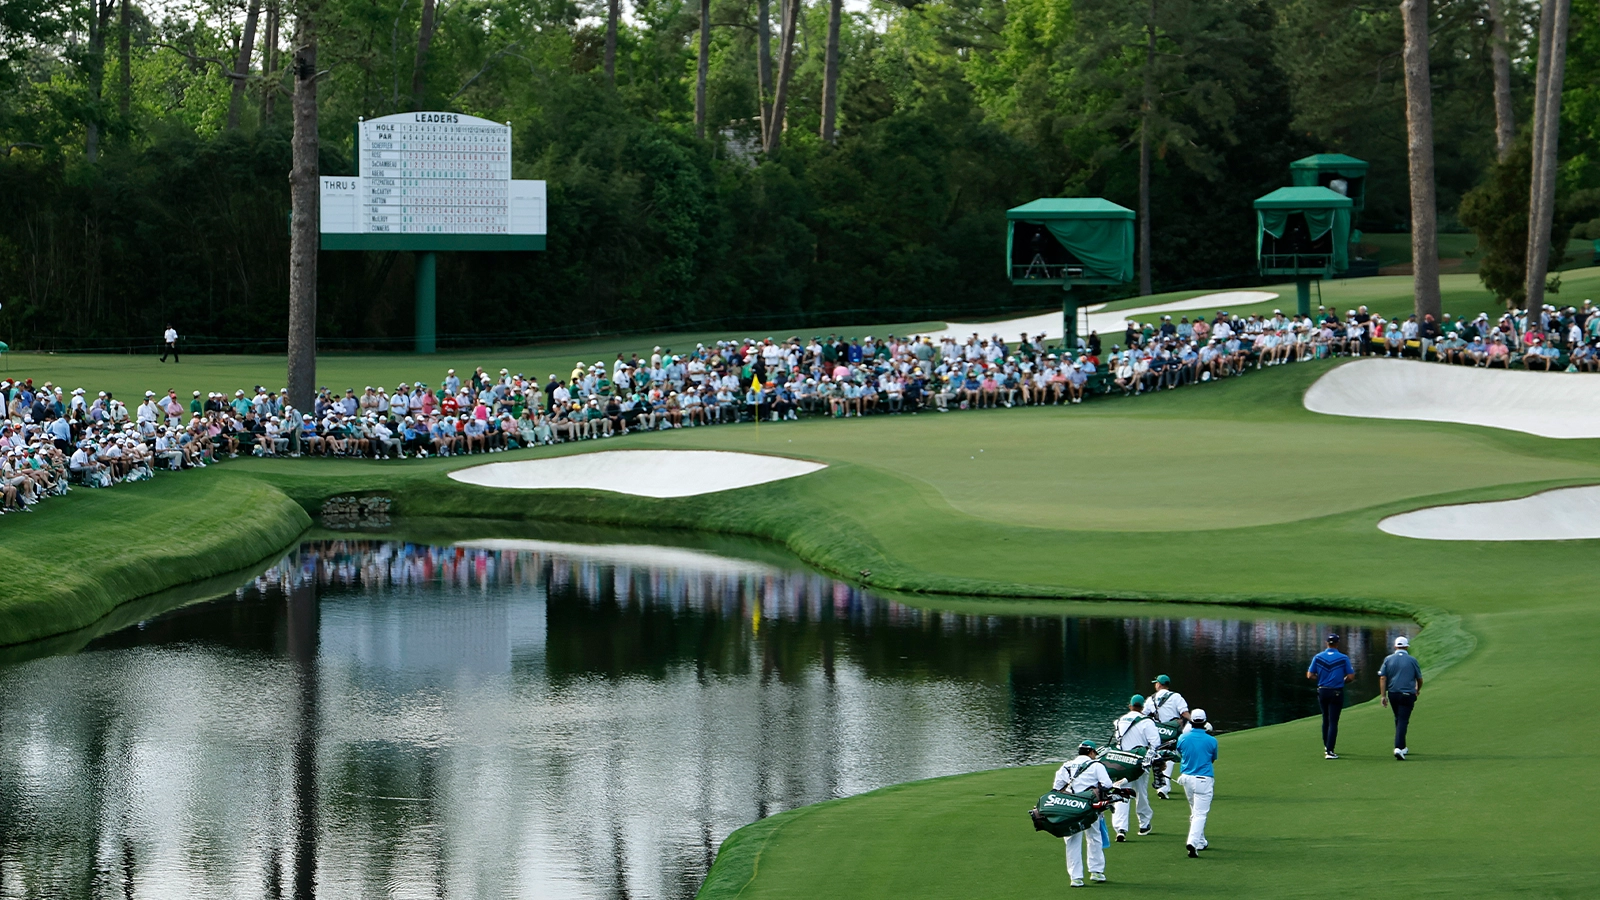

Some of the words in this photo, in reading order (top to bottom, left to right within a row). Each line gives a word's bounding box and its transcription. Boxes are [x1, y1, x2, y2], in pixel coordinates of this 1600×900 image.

[415, 114, 458, 123] LEADERS
[324, 181, 347, 189] THRU
[351, 181, 356, 189] 5
[1106, 753, 1138, 765] CRUSHERS
[1044, 794, 1086, 809] SRIXON
